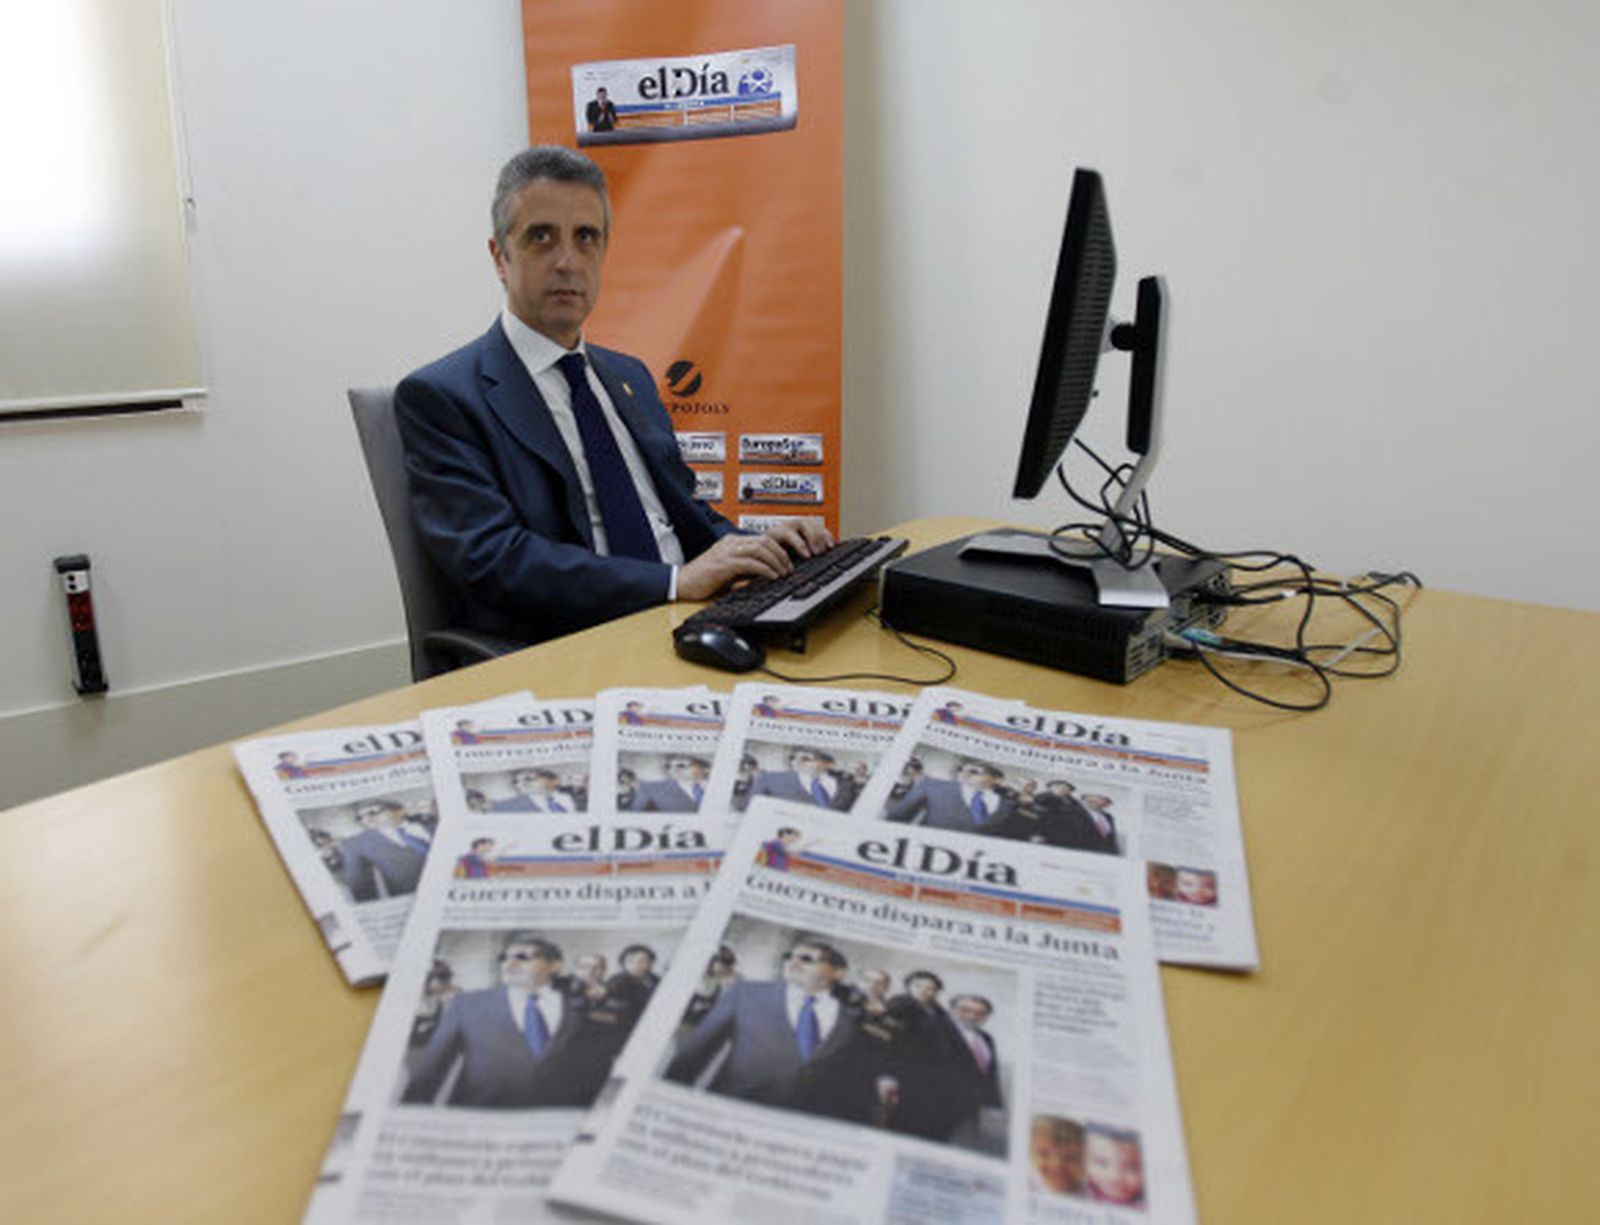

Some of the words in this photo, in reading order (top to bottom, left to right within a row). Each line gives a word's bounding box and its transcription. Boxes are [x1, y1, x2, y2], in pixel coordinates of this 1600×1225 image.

[843, 727, 896, 744] dispa
[448, 884, 573, 903] Guerrero
[576, 881, 672, 905] dispara
[745, 872, 869, 916] Guerrero
[872, 900, 975, 938] dispara
[980, 922, 998, 942] a
[1004, 924, 1032, 947] la
[1036, 930, 1121, 962] Junta
